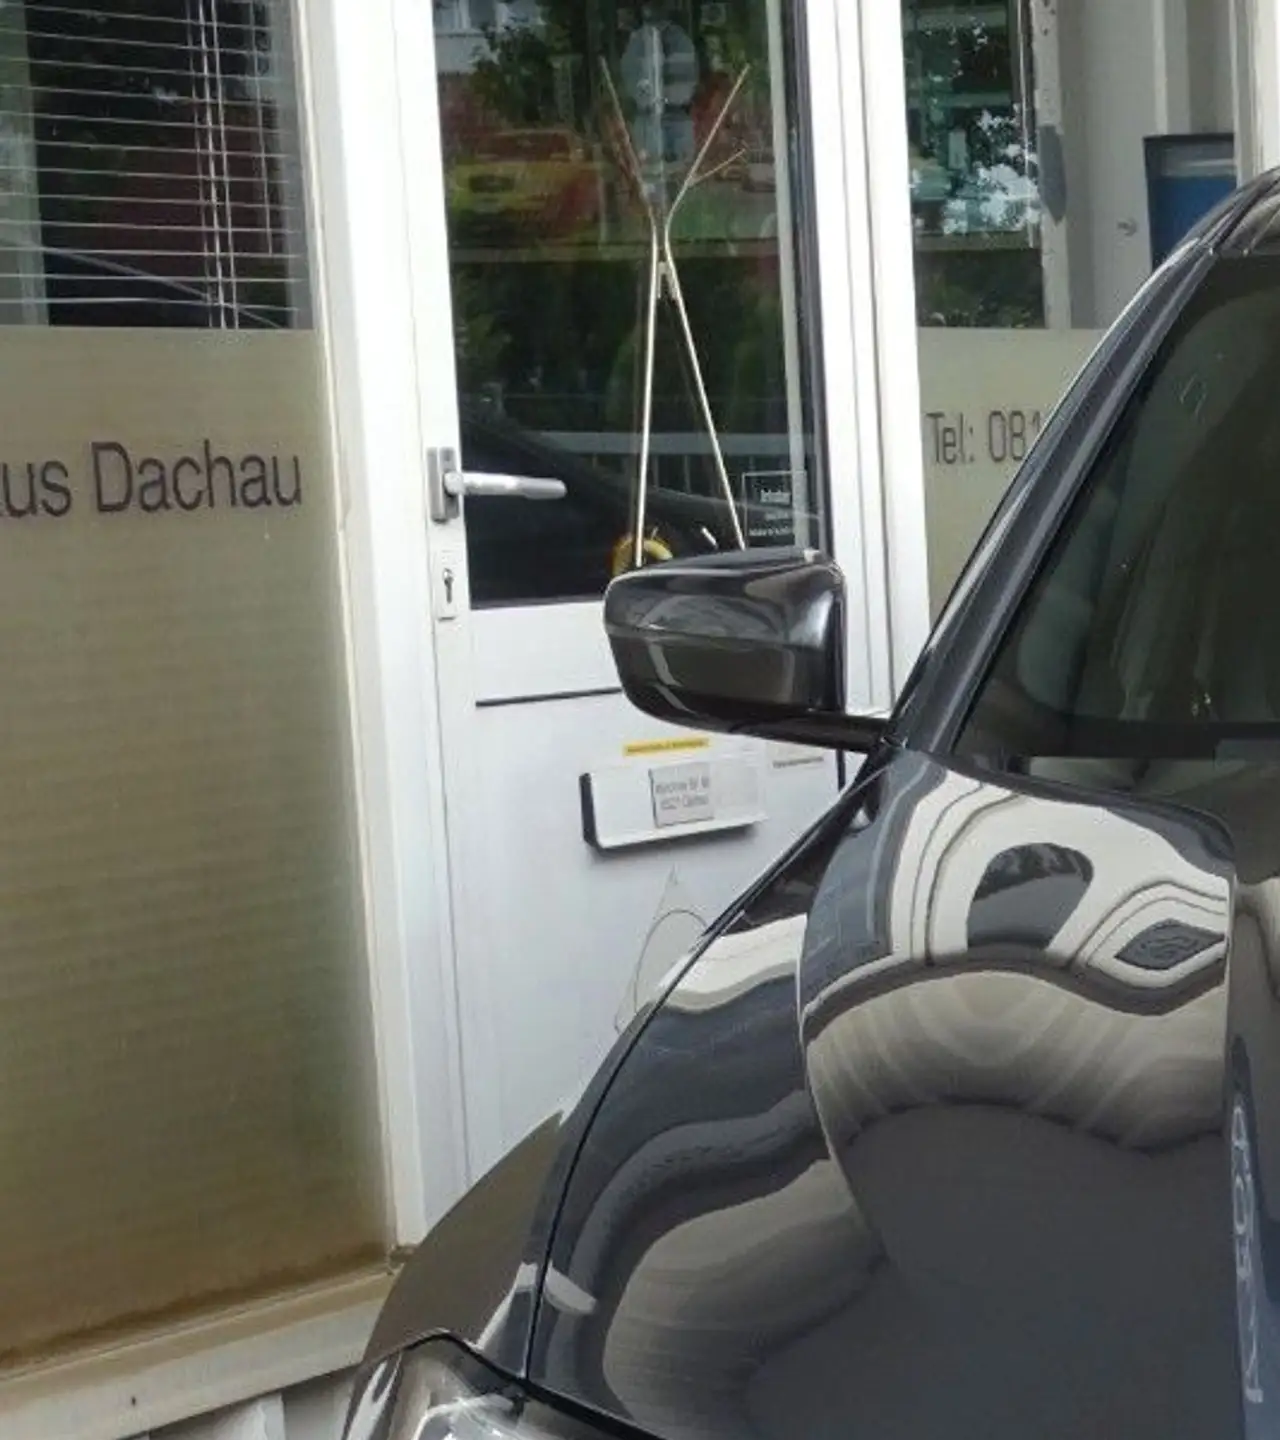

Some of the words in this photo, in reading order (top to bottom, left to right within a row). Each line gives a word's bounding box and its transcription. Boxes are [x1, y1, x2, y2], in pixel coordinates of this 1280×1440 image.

[926, 411, 975, 464] Tel:
[0, 460, 72, 517] us
[91, 438, 303, 513] Dachau
